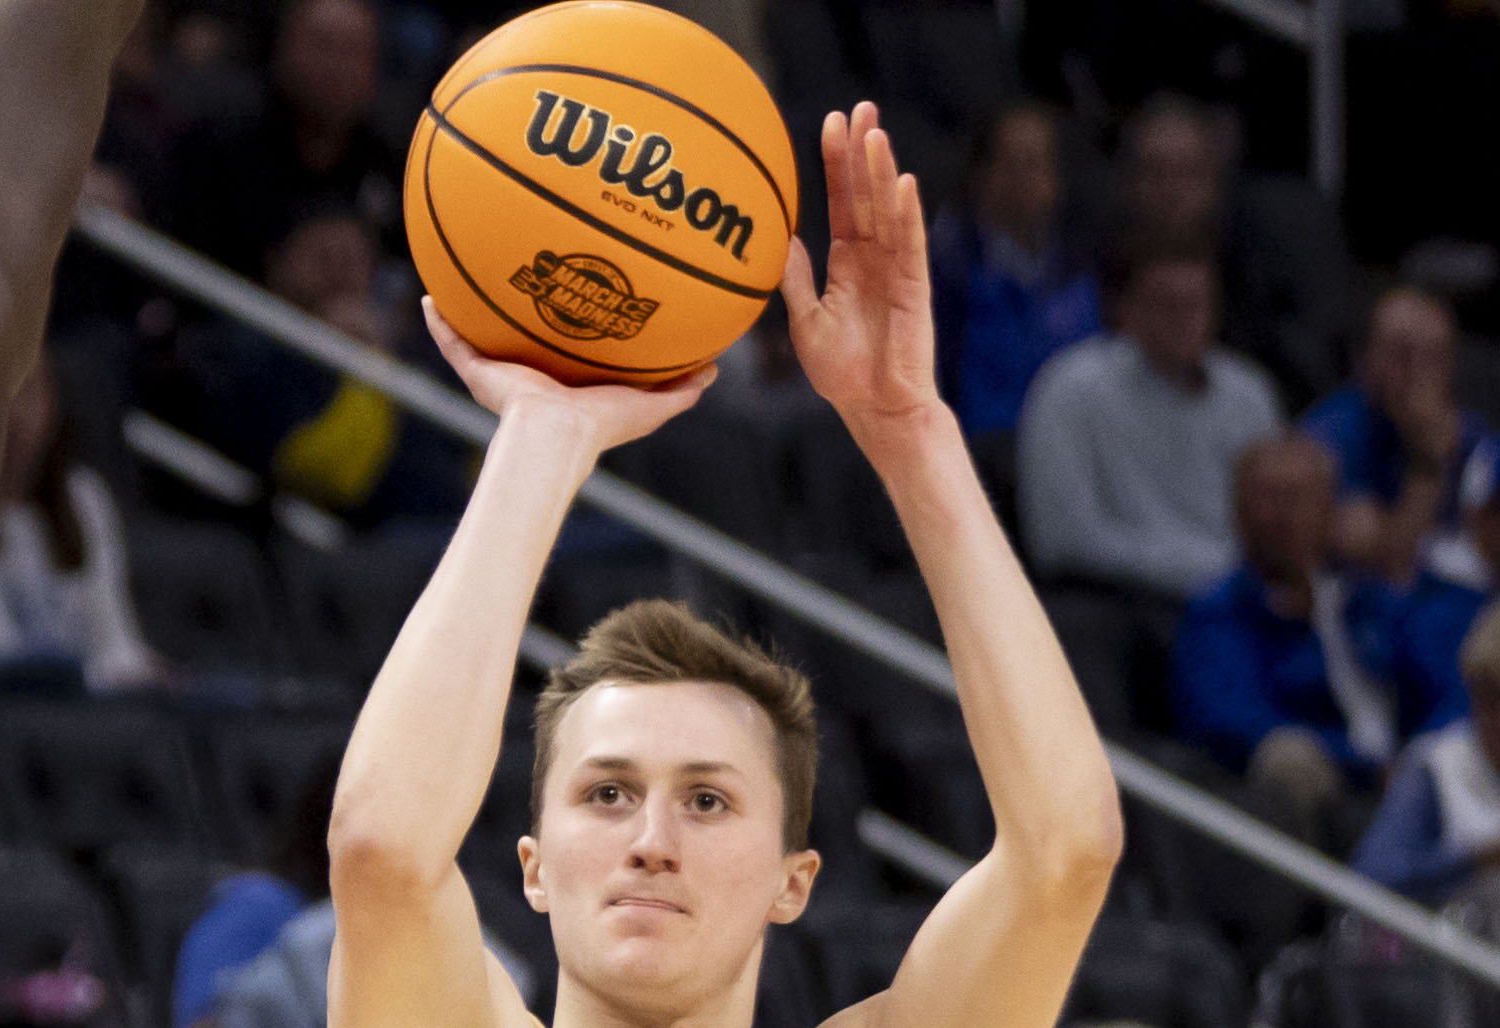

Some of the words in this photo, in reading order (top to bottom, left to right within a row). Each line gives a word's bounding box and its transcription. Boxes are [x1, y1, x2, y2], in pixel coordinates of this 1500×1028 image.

[527, 90, 753, 262] Wilson
[601, 190, 637, 213] EVO
[641, 209, 675, 231] NXT
[548, 285, 645, 336] MADNESS
[550, 264, 624, 310] MARCH
